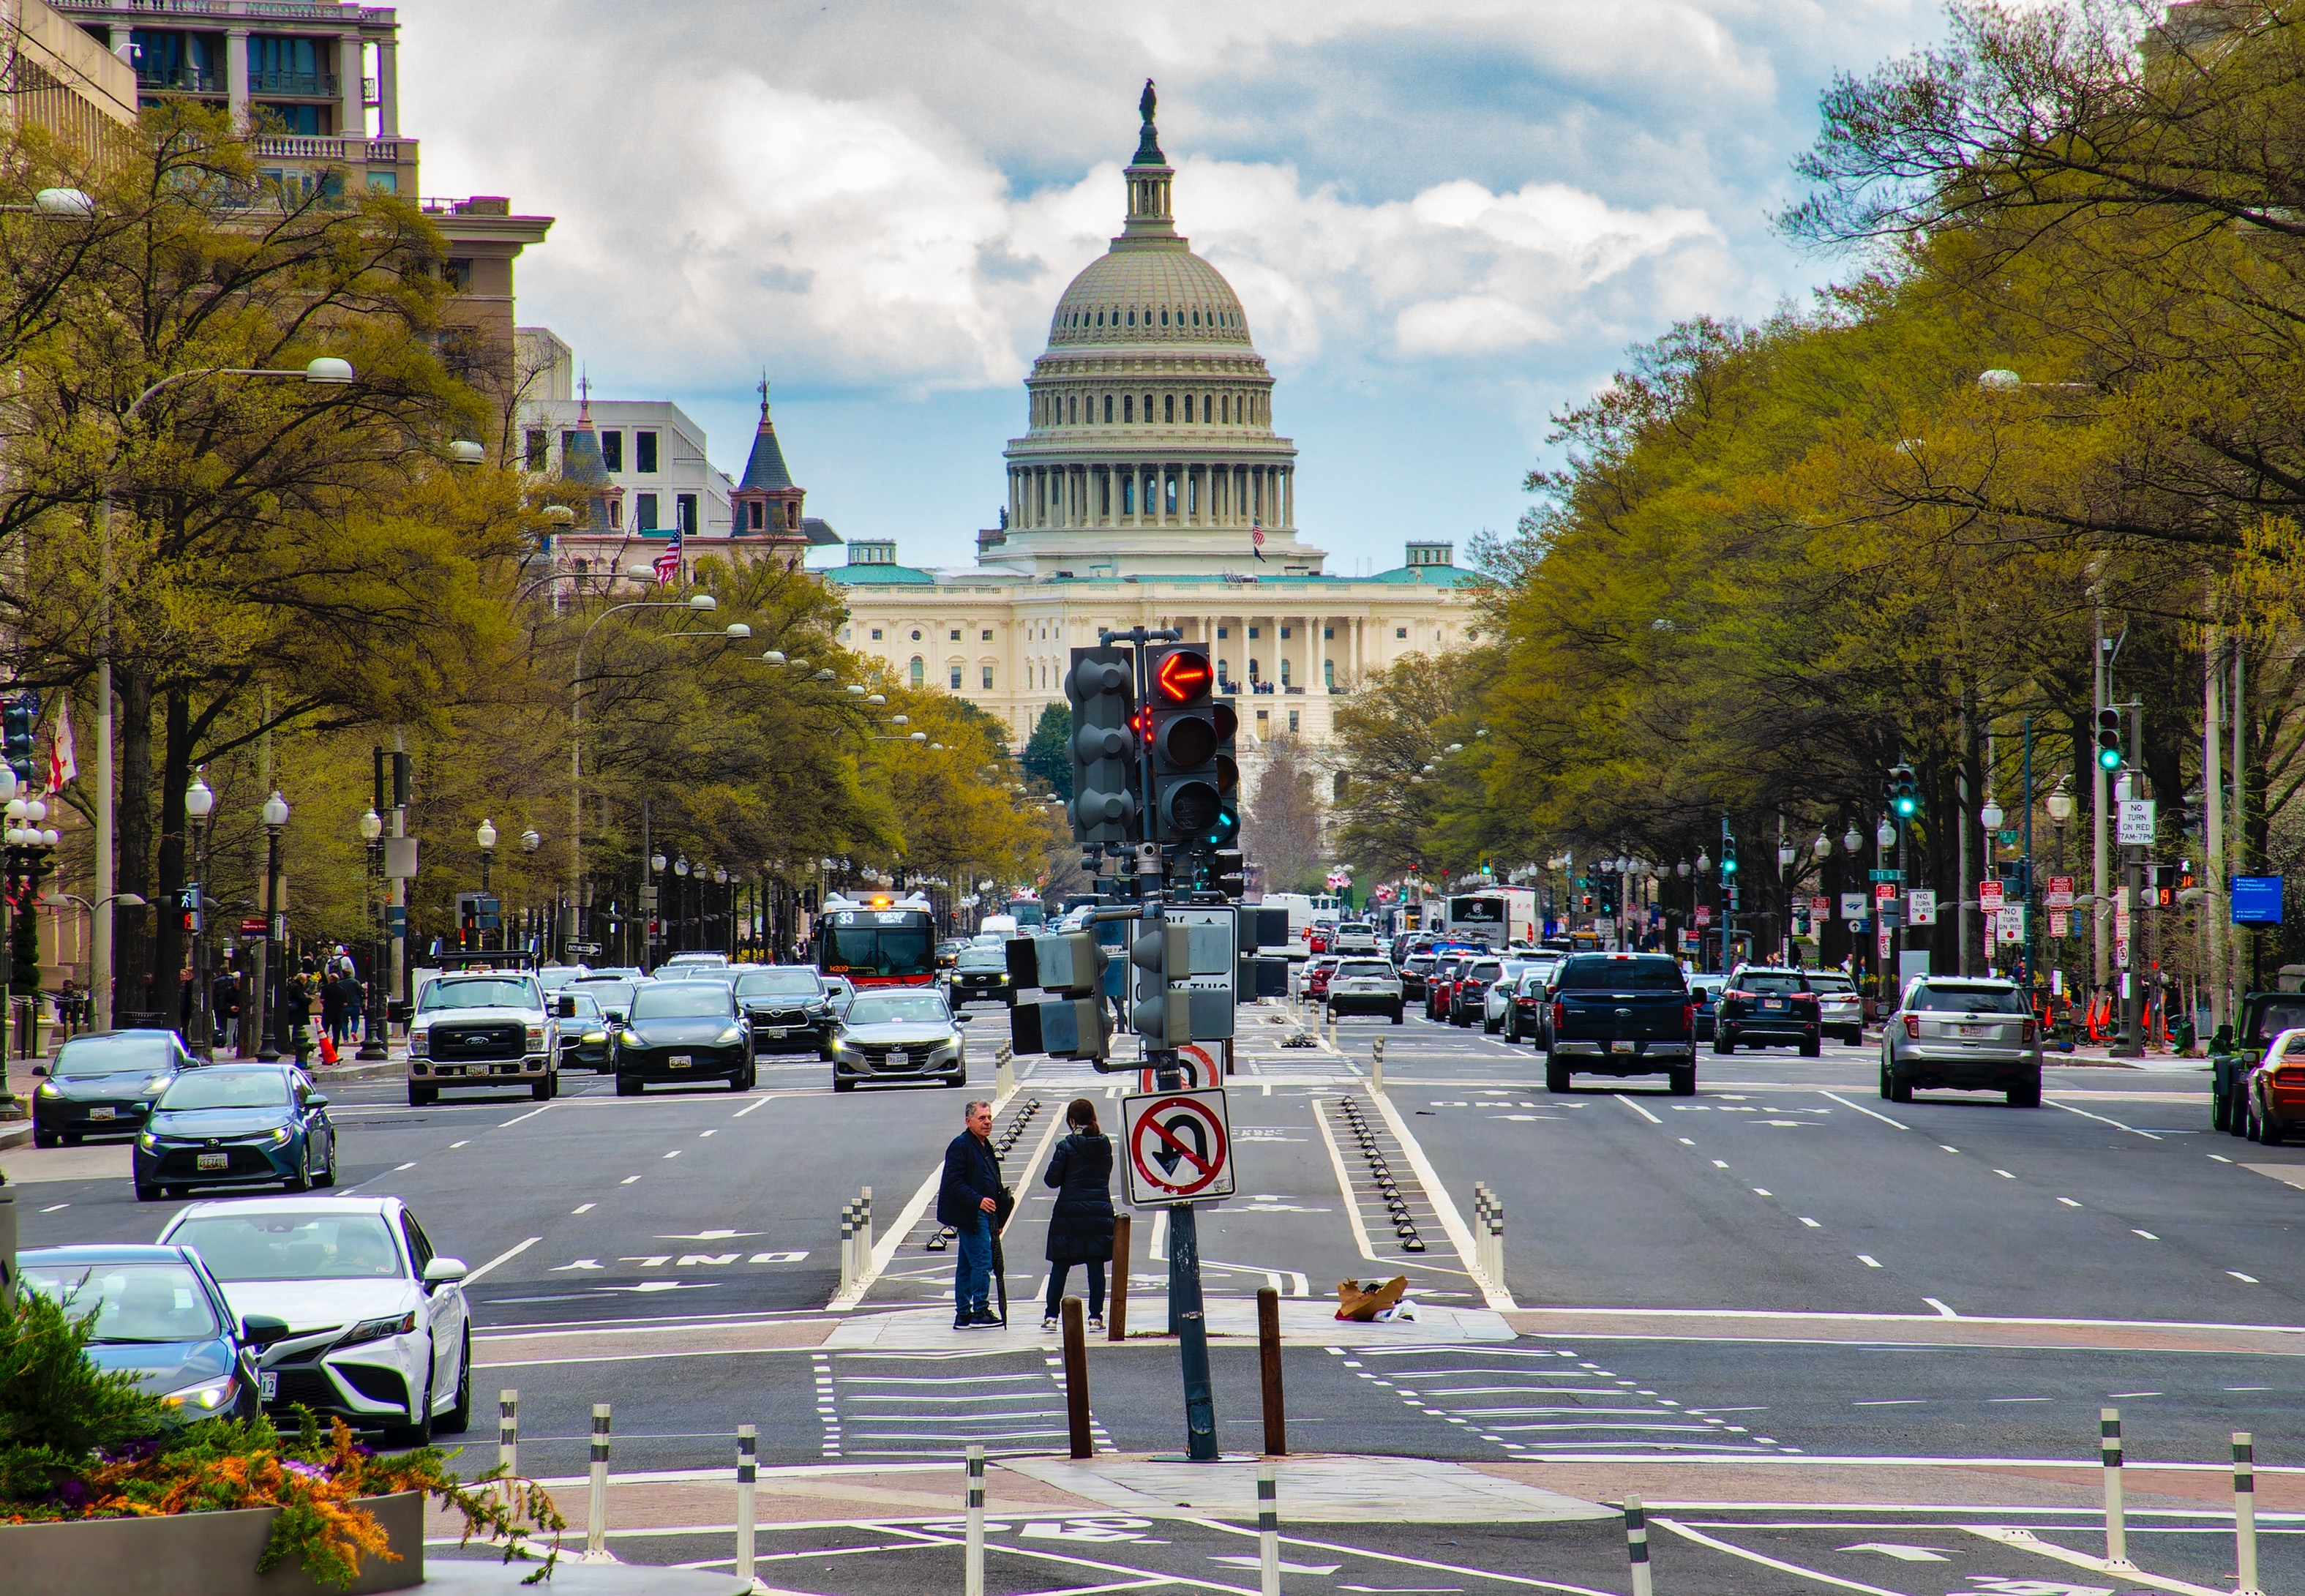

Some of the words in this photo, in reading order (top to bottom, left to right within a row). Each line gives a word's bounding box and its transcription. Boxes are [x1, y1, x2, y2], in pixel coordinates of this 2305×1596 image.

[2159, 889, 2169, 904] 19
[839, 912, 854, 923] 33
[1671, 1106, 1834, 1114] ONLY
[548, 1251, 811, 1271] ONLY
